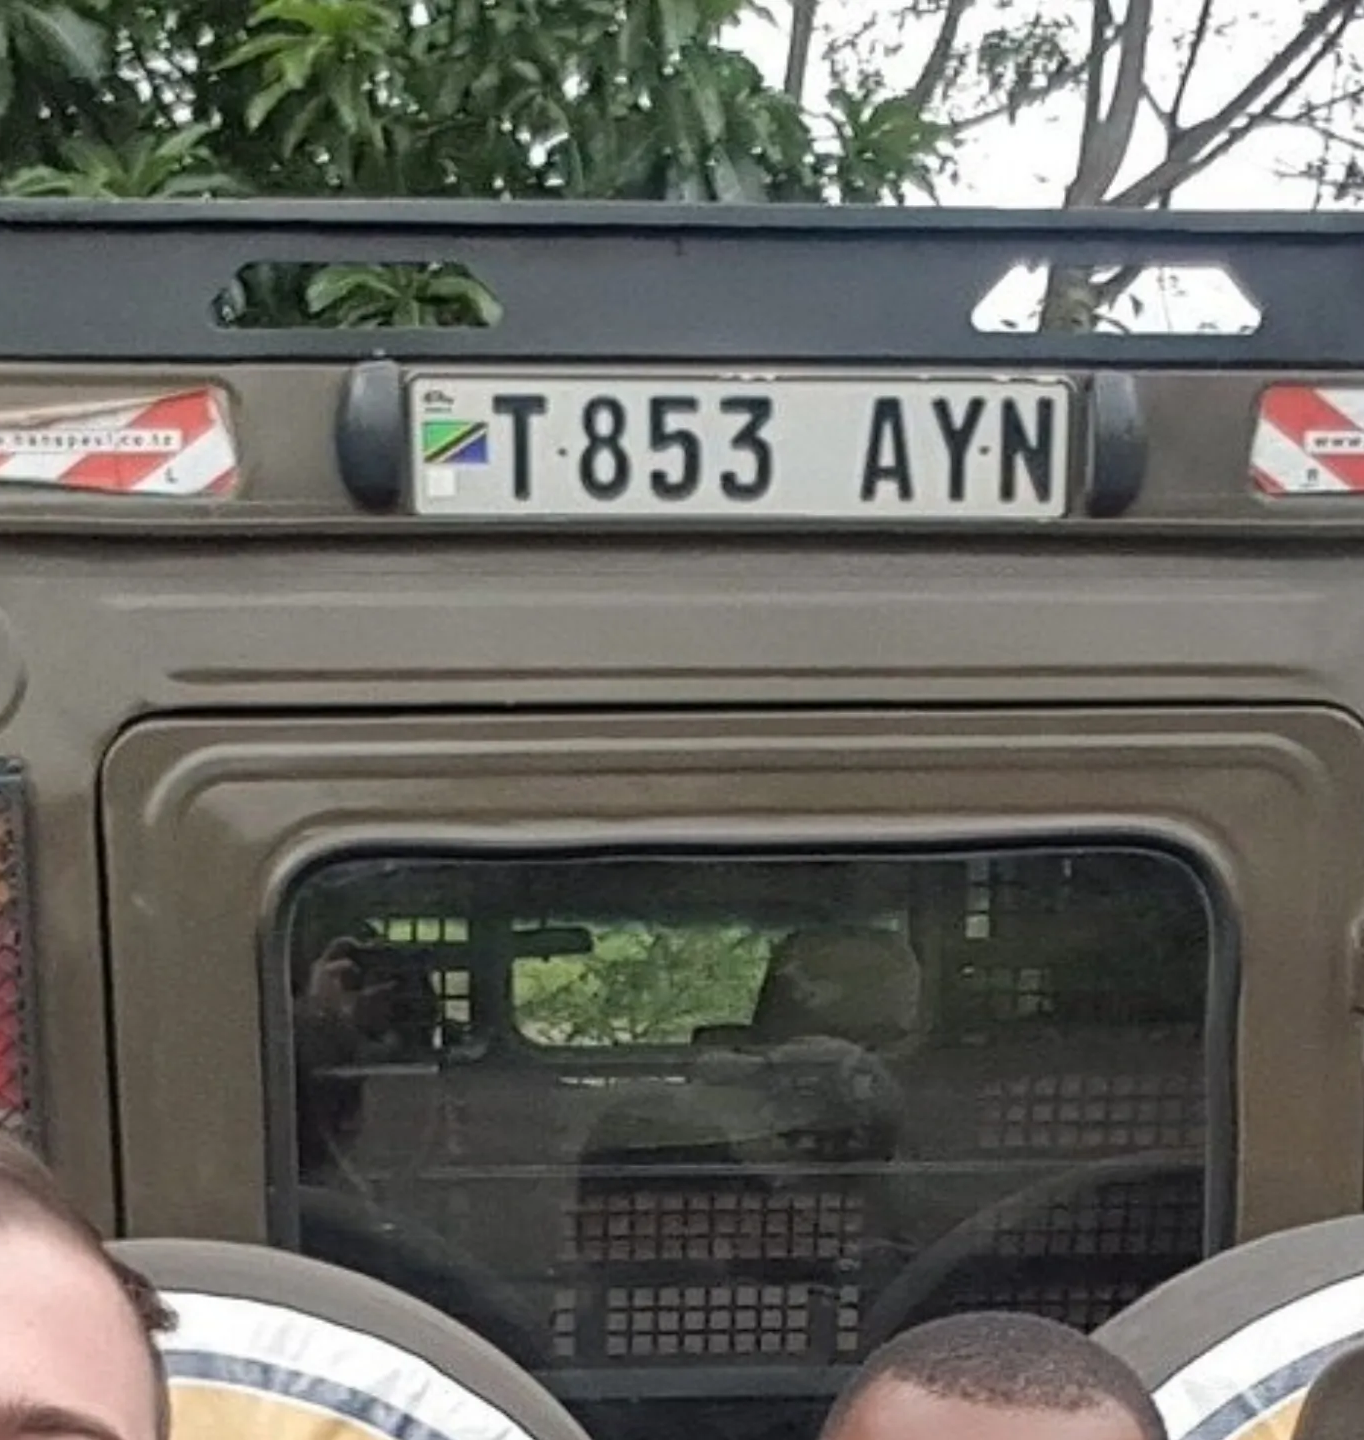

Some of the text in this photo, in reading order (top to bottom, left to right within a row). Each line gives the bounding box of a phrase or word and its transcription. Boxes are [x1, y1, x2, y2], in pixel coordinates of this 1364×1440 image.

[492, 393, 1053, 502] T 853 AYN
